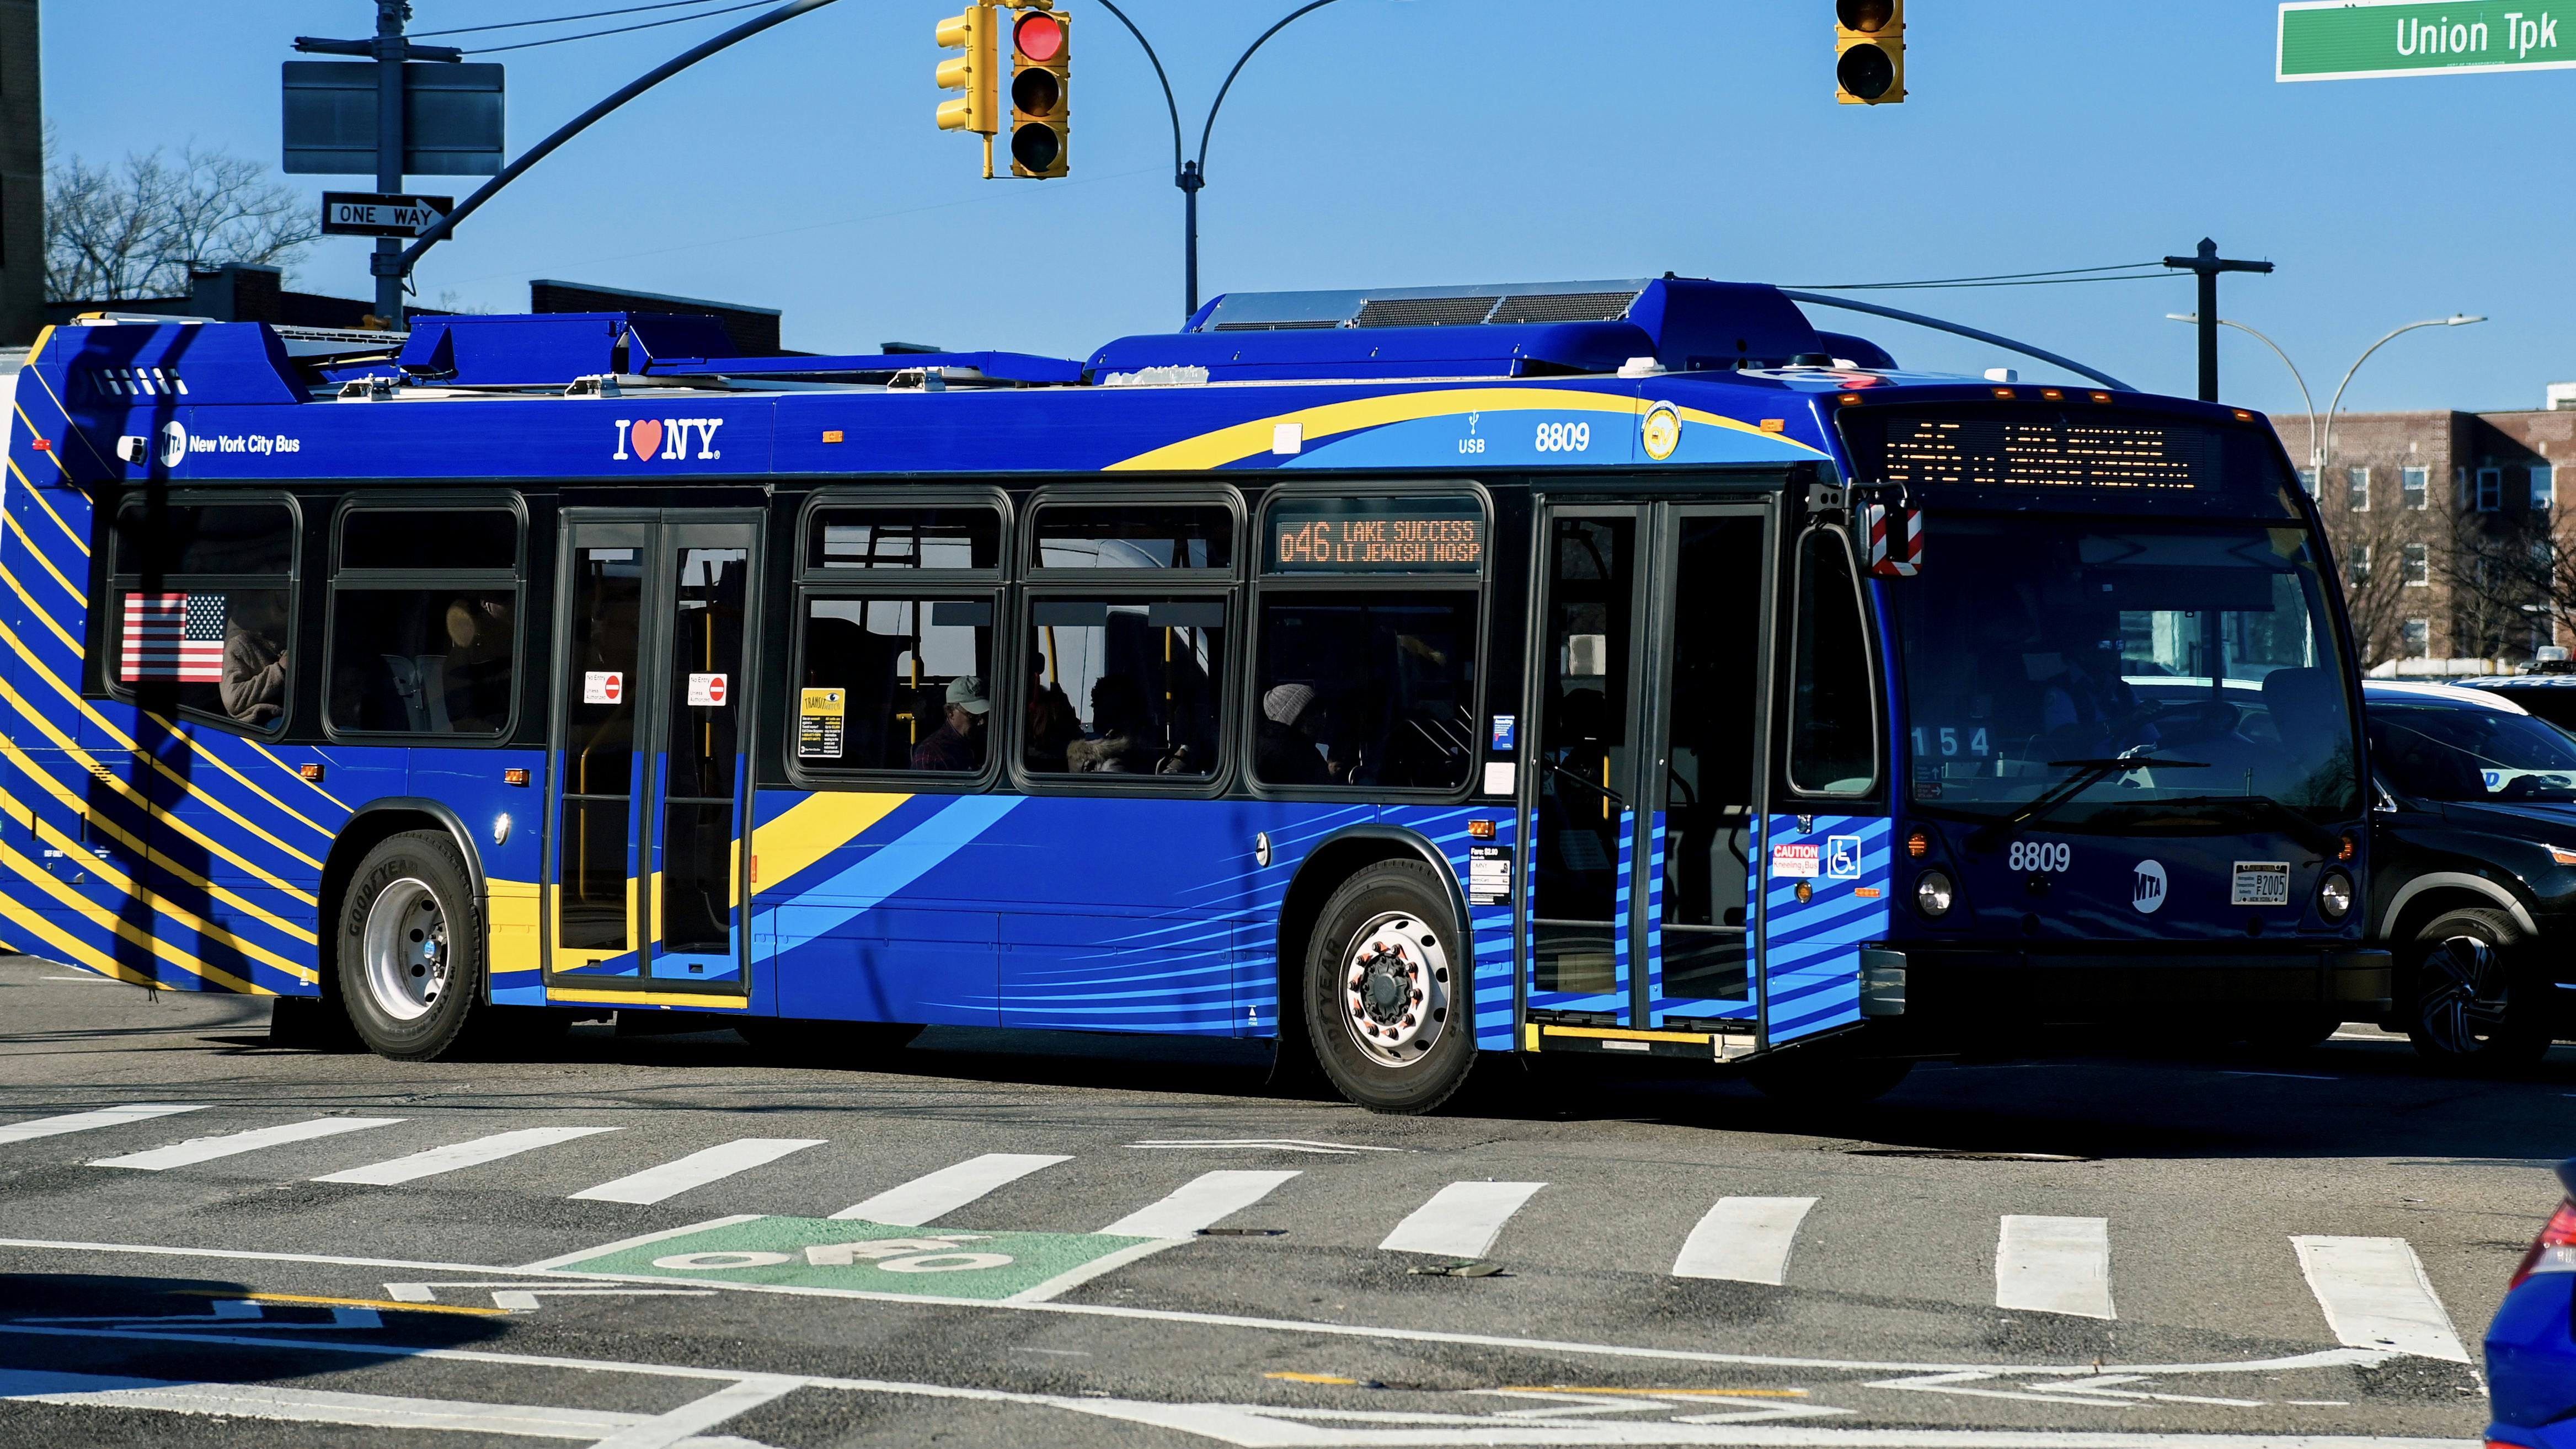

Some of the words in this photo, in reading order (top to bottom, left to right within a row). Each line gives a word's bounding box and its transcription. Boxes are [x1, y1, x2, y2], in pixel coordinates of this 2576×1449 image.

[2397, 16, 2487, 55] Union
[2504, 12, 2558, 59] Tpk
[340, 206, 376, 223] ONE
[394, 208, 433, 226] WAY
[189, 435, 217, 452] New
[218, 435, 245, 452] York
[248, 435, 274, 456] City
[276, 435, 300, 452] Bus
[613, 419, 630, 460] I
[1458, 439, 1485, 454] USB
[1535, 422, 1590, 452] 8809
[1343, 521, 1386, 542] LAKE
[1393, 521, 1474, 542] SUCCESS
[1337, 543, 1354, 562] LI
[1361, 543, 1426, 562] JEWISH
[1434, 543, 1481, 562] HOSP
[805, 696, 826, 710] TRANSIT
[1774, 846, 1818, 858] CAUTION
[2009, 841, 2070, 872] 8809
[1773, 860, 1802, 869] Kneeling
[2133, 871, 2161, 902] MTA
[2262, 875, 2285, 895] 2005
